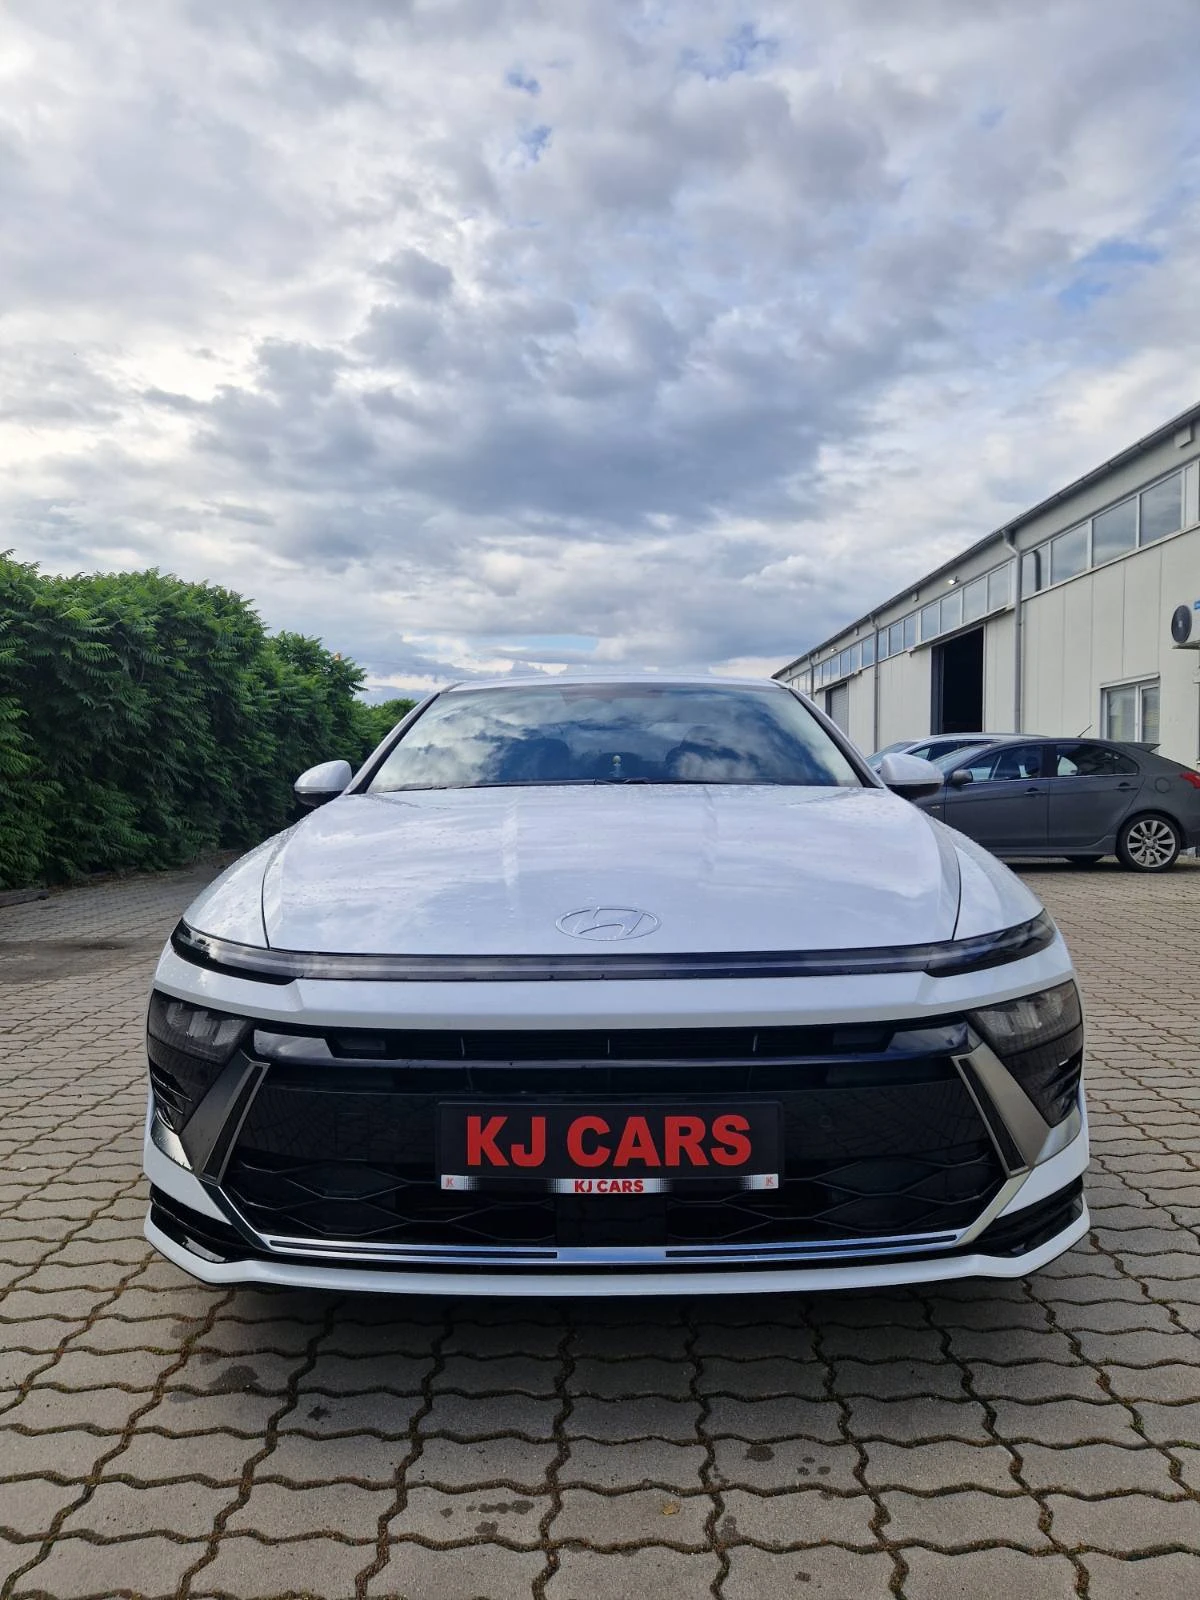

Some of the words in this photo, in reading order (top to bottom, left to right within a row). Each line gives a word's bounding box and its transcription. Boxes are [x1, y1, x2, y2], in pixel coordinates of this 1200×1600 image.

[467, 1116, 546, 1168] KJ
[567, 1114, 752, 1169] CARS
[574, 1180, 593, 1193] KJ
[597, 1179, 644, 1193] CARS
